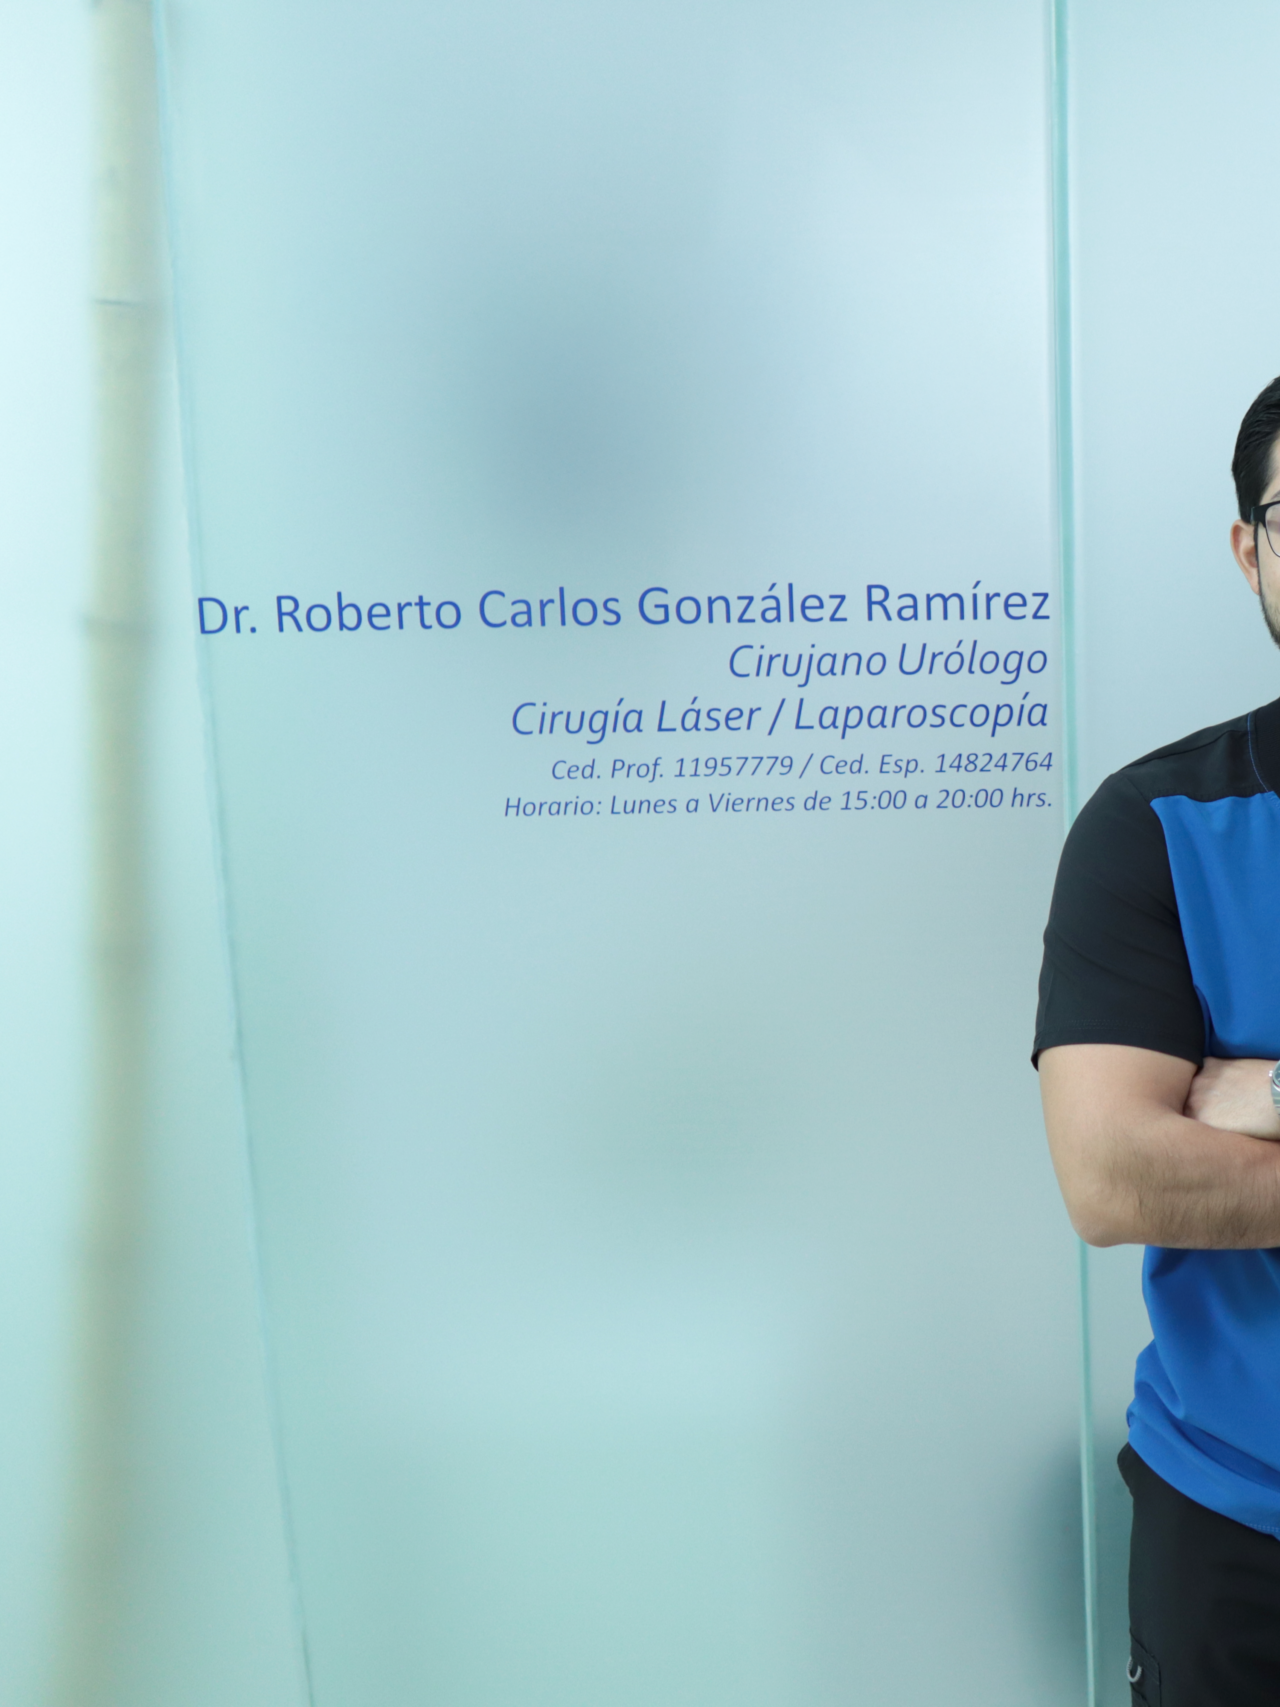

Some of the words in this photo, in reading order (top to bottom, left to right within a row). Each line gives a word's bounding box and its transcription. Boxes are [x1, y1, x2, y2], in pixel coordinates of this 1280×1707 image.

[198, 596, 258, 636] Dr.
[276, 590, 463, 634] Roberto
[479, 585, 623, 629] Carlos
[638, 582, 849, 625] González
[866, 579, 1051, 622] Ramírez
[729, 644, 888, 688] Cirujano
[899, 639, 1048, 685] Urólogo
[512, 697, 644, 745] Cirugía
[656, 695, 763, 733] Láser
[767, 697, 787, 736] /
[795, 691, 1049, 740] Laparoscopía
[551, 758, 602, 780] Ced.
[611, 757, 665, 784] Prof.
[673, 755, 794, 778] 11957779
[799, 753, 815, 779] /
[820, 753, 870, 775] Ced.
[879, 753, 926, 778] Esp.
[935, 751, 1053, 773] 14824764
[505, 796, 603, 817] Horario:
[610, 795, 678, 815] Lunes
[685, 798, 700, 814] a
[709, 792, 796, 813] Viernes
[803, 790, 833, 812] de
[841, 789, 908, 811] 15:00
[914, 794, 929, 810] a
[936, 787, 1005, 810] 20:00
[1011, 787, 1053, 808] hrs.
